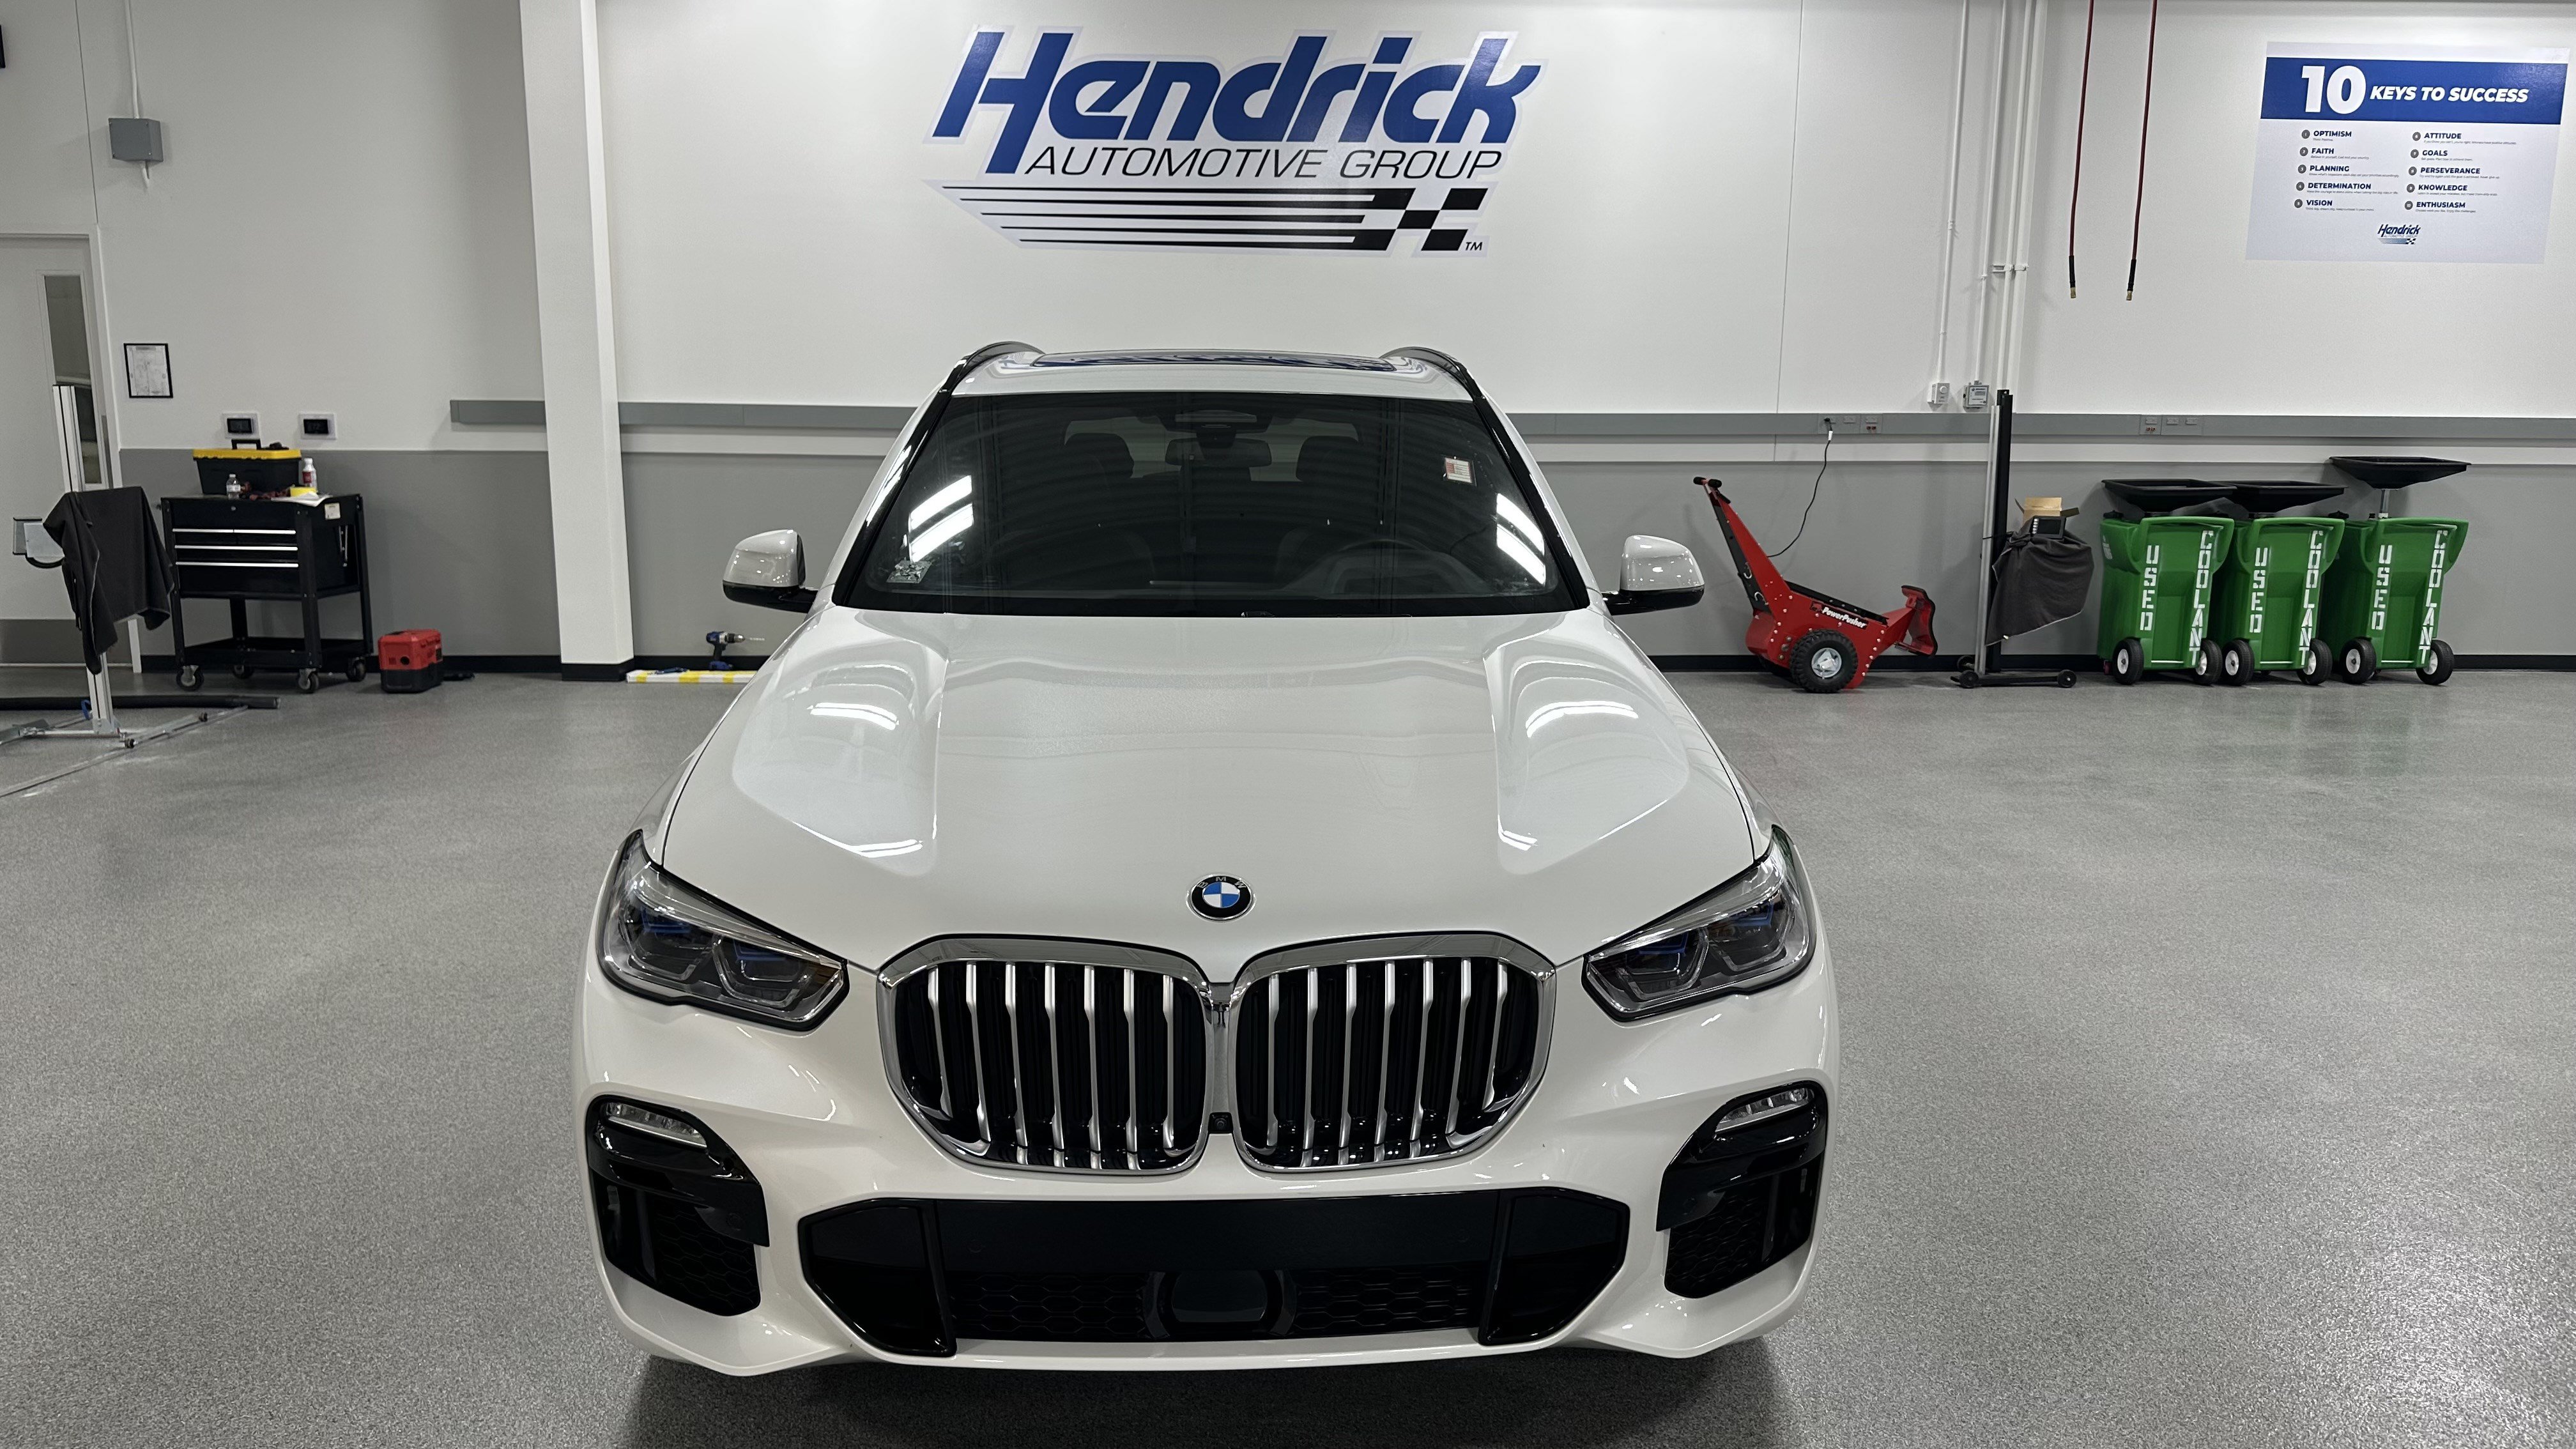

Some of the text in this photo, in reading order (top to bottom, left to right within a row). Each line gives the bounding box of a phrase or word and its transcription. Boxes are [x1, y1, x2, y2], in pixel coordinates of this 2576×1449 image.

[934, 33, 1540, 174] Hendrick
[2301, 65, 2529, 114] 10 KEYS TO SUCCESS
[1023, 146, 1502, 180] AUTOMOTIVE GROUP
[1464, 241, 1483, 251] TM
[2377, 224, 2421, 238] Hendrick
[1821, 606, 1867, 629] PowerPusher
[2140, 545, 2159, 631] USED
[2189, 530, 2214, 666] COOLANT
[2250, 548, 2267, 633] USED
[2299, 530, 2323, 666] COOLANT
[2372, 545, 2393, 630] USED
[2419, 530, 2448, 664] COOLANT
[1196, 876, 1246, 889] BMW
